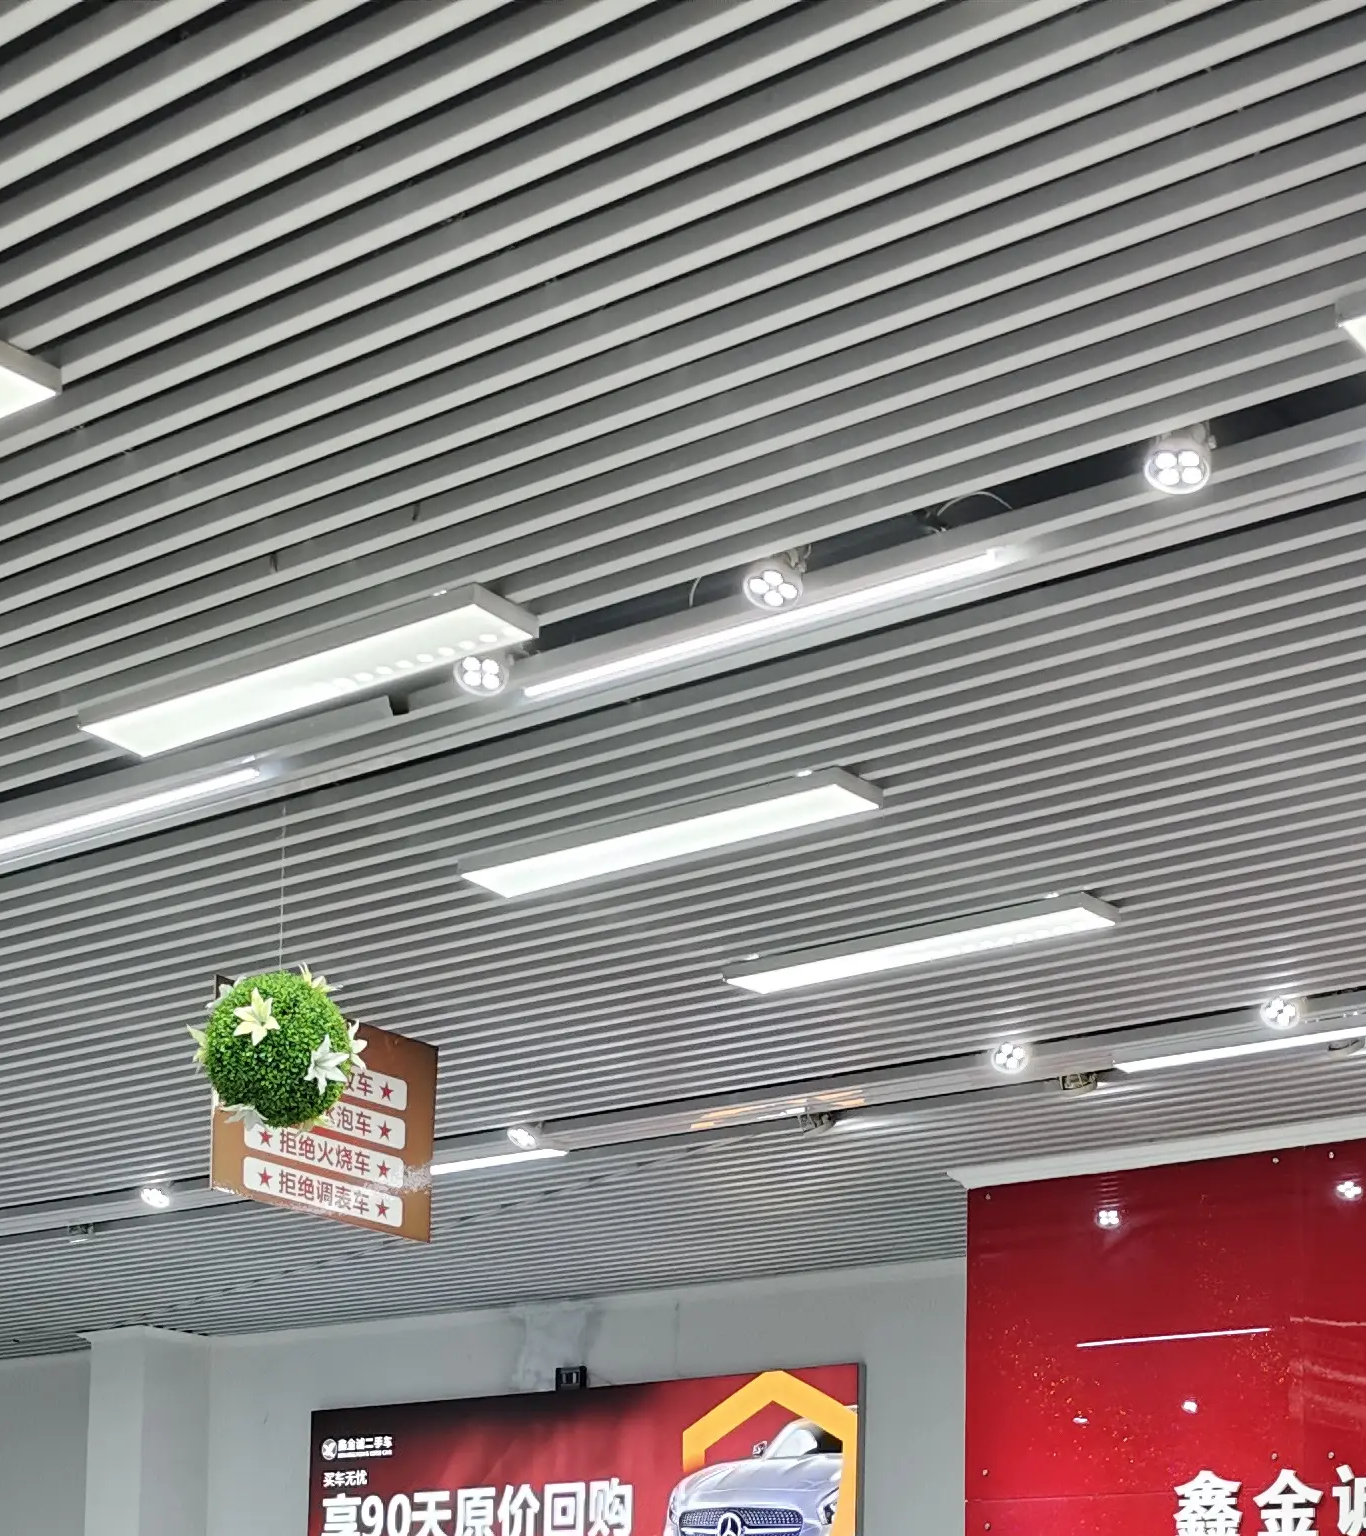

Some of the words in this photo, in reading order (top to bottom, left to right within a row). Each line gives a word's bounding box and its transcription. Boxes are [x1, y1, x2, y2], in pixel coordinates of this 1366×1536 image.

[279, 1130, 371, 1176] 拒绝火烧车
[278, 1169, 370, 1215] 拒绝调表车
[322, 1469, 368, 1488] 买车无忧
